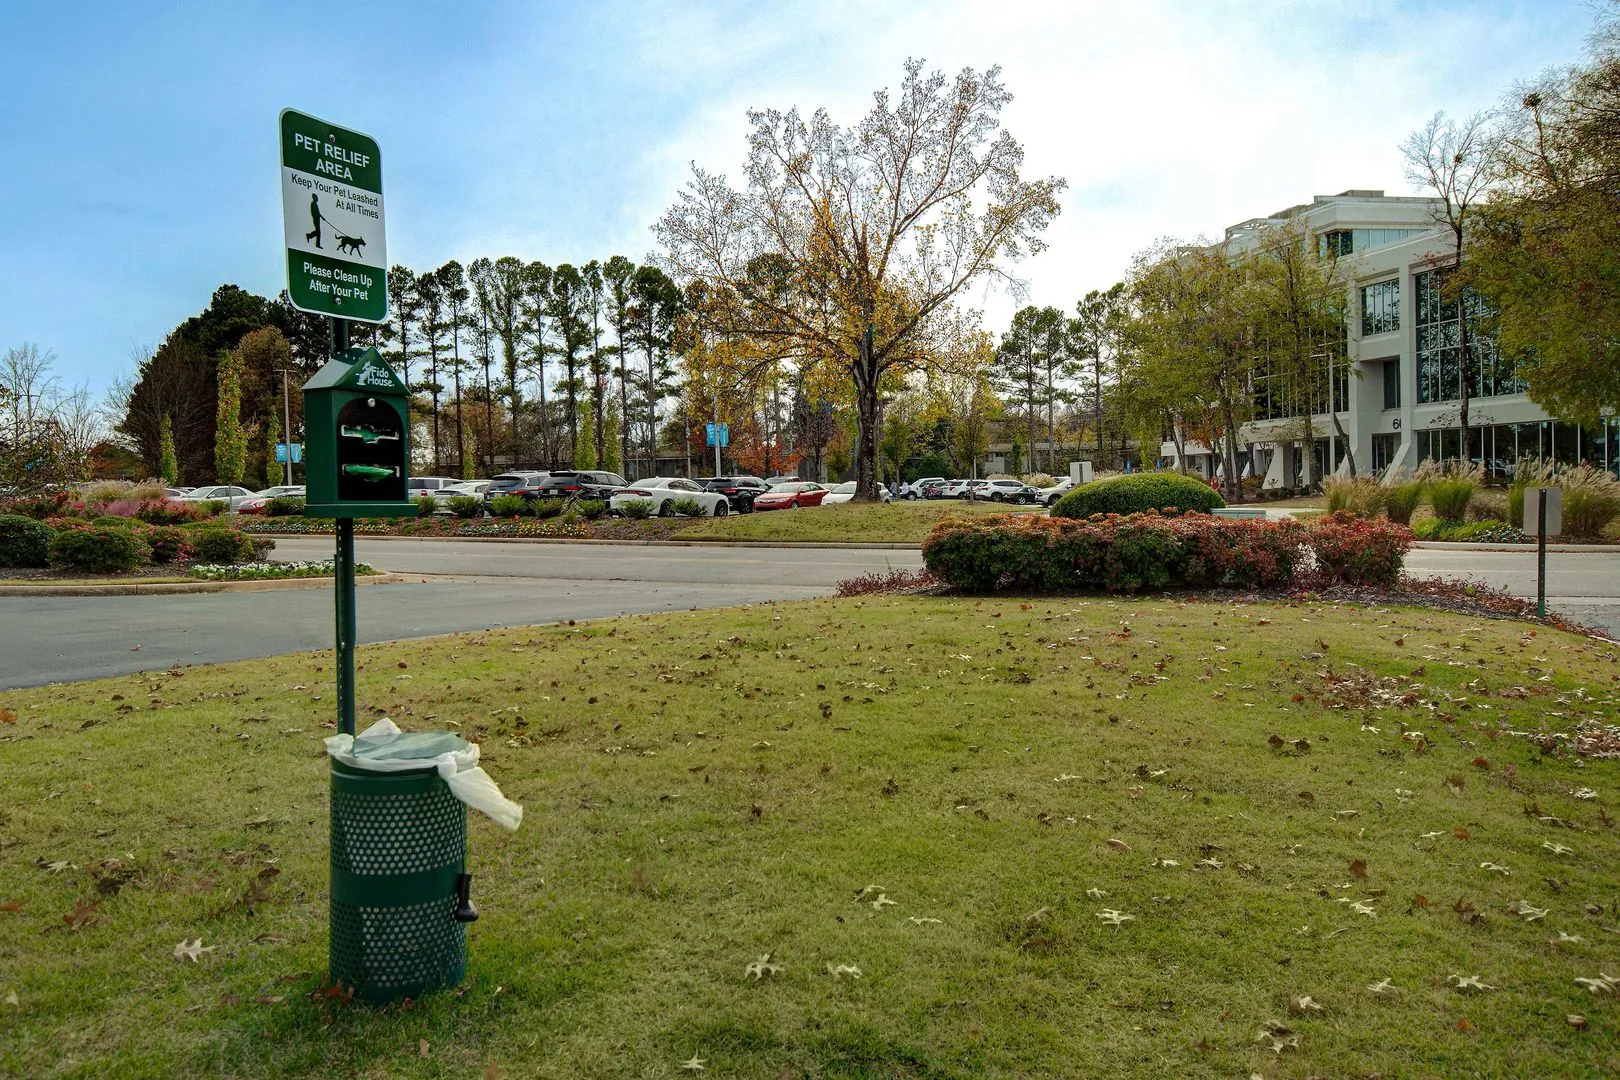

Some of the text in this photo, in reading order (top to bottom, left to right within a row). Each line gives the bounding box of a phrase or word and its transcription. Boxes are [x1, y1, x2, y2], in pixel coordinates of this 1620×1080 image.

[295, 133, 370, 168] PET RELIEF
[316, 159, 353, 181] AREA
[291, 173, 378, 207] Keep Your Pet Leashed
[336, 199, 379, 219] At All Times
[303, 261, 373, 289] Please Clean Up
[309, 279, 369, 301] After Your Pet
[370, 366, 389, 378] Fido
[1392, 418, 1402, 430] 6
